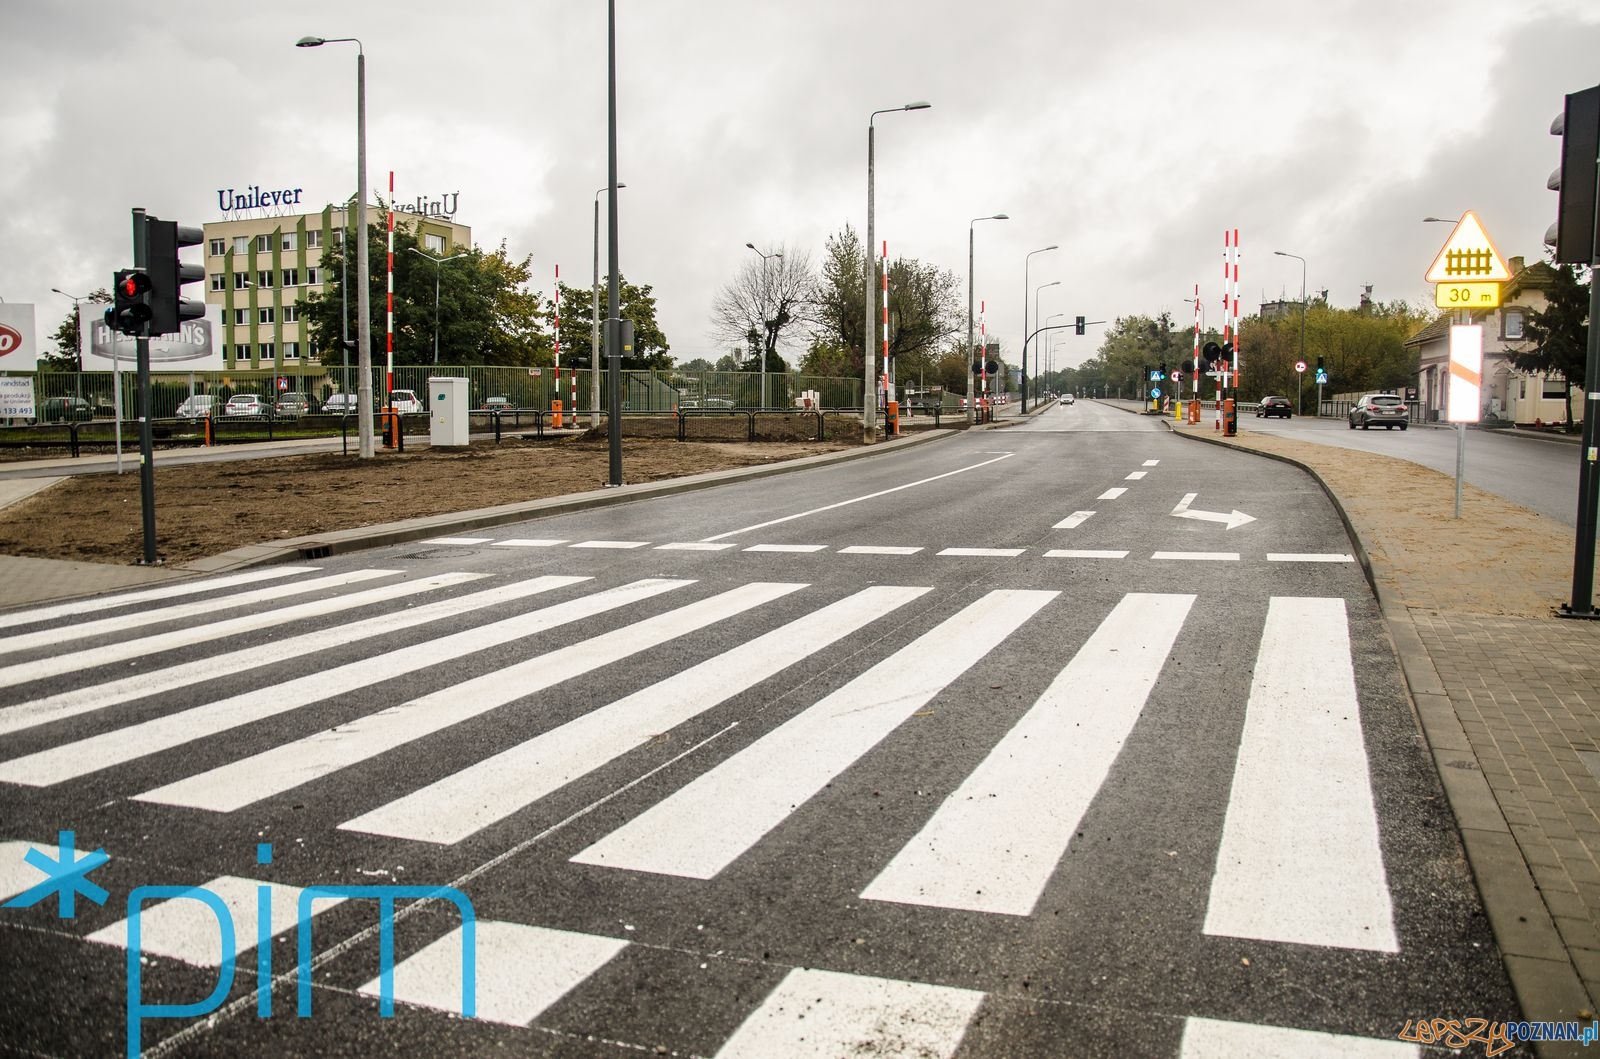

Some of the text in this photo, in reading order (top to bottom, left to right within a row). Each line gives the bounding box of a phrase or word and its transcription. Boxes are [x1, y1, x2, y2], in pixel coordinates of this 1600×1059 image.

[217, 185, 303, 211] Unilever
[1449, 288, 1492, 302] 30 m
[4, 407, 33, 415] 133 493
